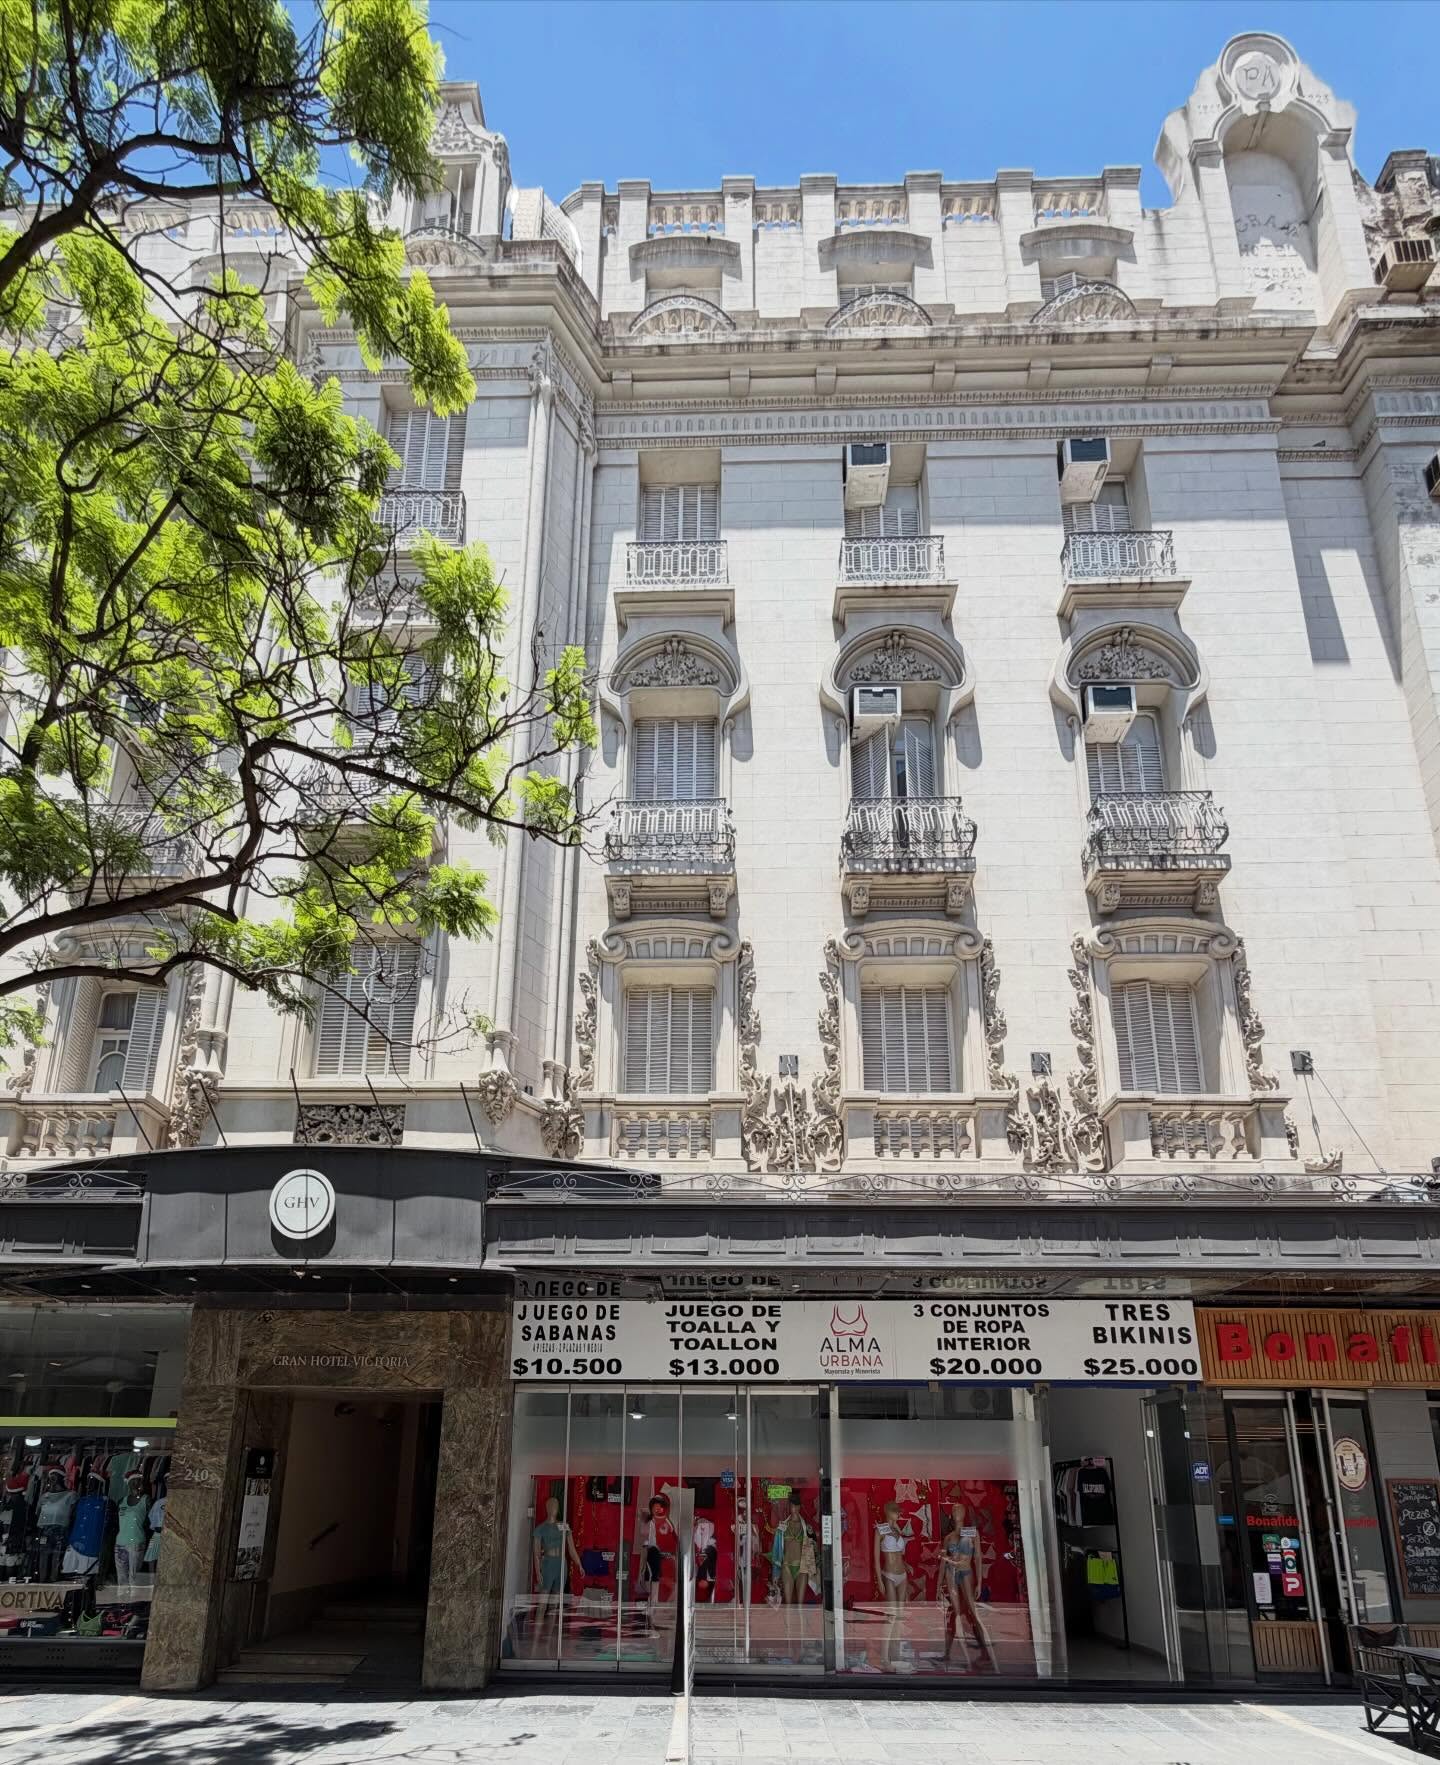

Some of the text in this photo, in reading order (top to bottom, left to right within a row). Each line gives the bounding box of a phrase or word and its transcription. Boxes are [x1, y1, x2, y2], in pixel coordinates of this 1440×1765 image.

[284, 1196, 320, 1209] GHV
[518, 1304, 620, 1320] JUEGO DE
[665, 1304, 781, 1317] JUEGO DE
[913, 1304, 1050, 1317] 3 CONJUNTOS
[1104, 1304, 1171, 1322] TRES
[521, 1324, 616, 1341] SABANAS
[666, 1321, 781, 1333] TOALLA Y
[943, 1320, 1026, 1333] DE ROPA
[1092, 1326, 1192, 1344] BIKINIS
[669, 1337, 777, 1350] TOALLON
[820, 1337, 881, 1352] ALMA
[936, 1337, 1031, 1350] INTERIOR
[273, 1355, 410, 1368] GRAN HOTEL VICTORIA
[512, 1358, 622, 1376] $10.500
[669, 1358, 780, 1376] $13.000
[820, 1354, 883, 1367] URBANA
[929, 1357, 1042, 1376] $20.000
[1083, 1358, 1198, 1376] $25.000
[184, 1468, 209, 1481] 240
[1194, 1466, 1209, 1475] ADT
